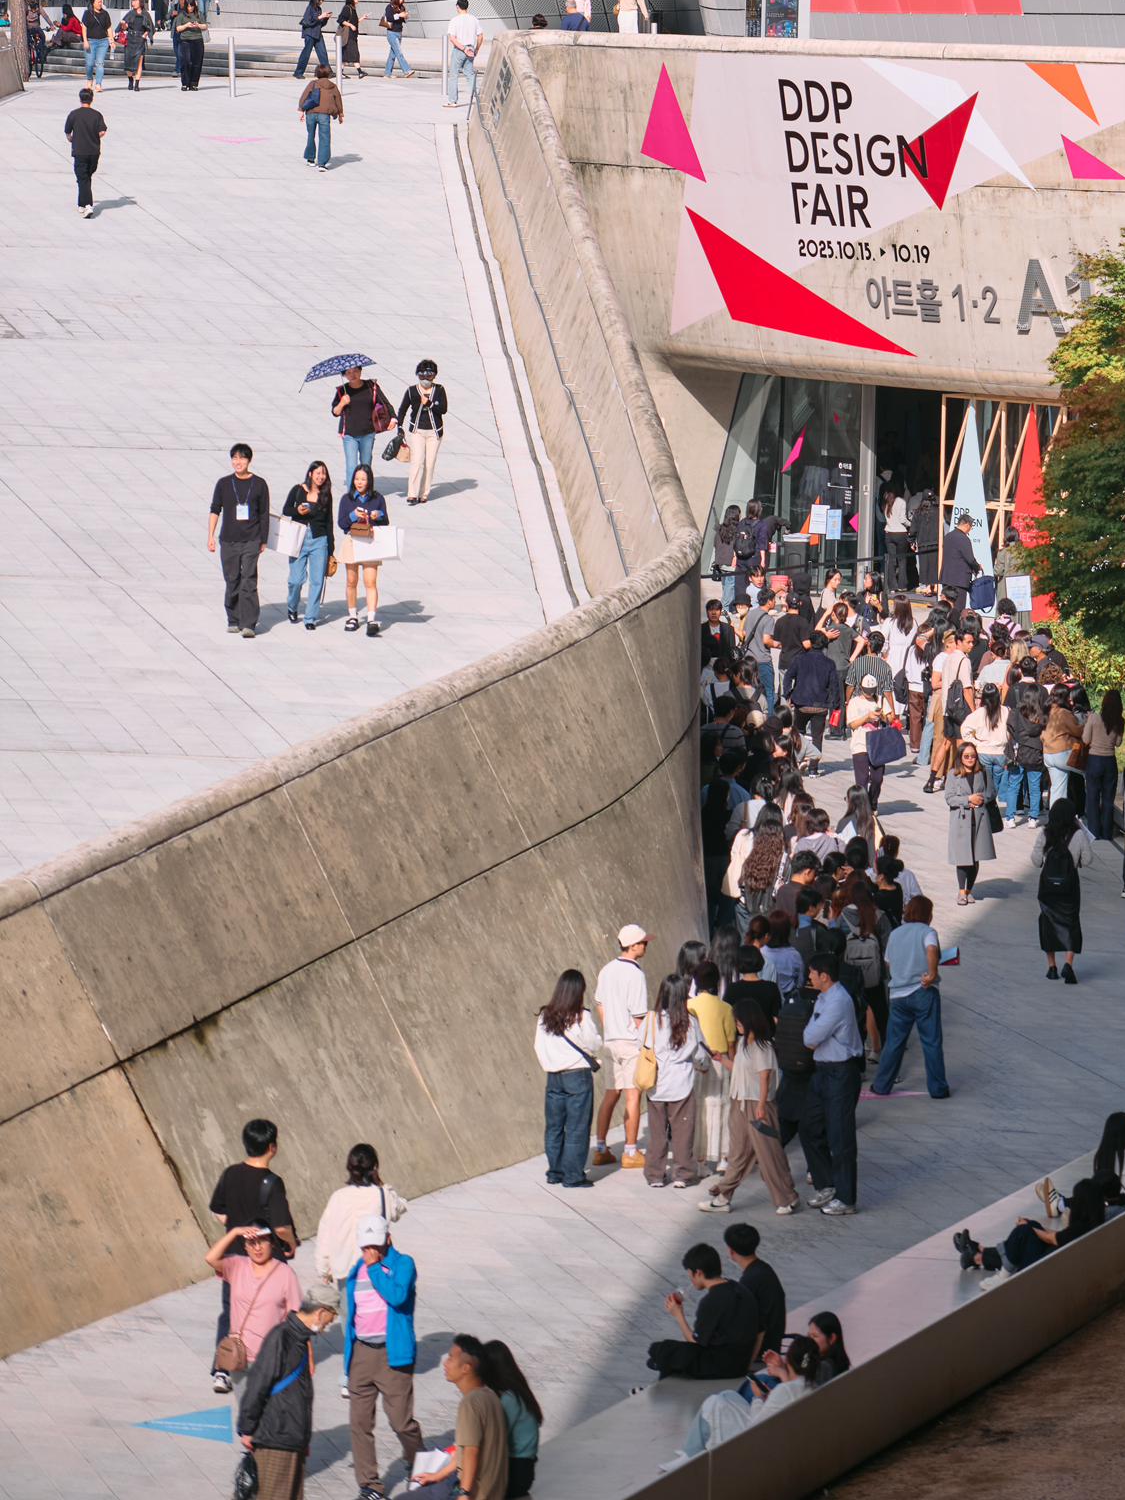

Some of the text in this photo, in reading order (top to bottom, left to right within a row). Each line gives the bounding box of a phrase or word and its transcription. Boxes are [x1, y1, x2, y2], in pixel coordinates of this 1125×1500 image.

[778, 78, 852, 124] DDP
[785, 130, 929, 180] DESIGN
[790, 181, 872, 229] FAIR
[798, 238, 931, 265] 2025.10.15. 10.19
[865, 276, 943, 324] 아트홀
[954, 506, 970, 516] DDP
[1014, 512, 1038, 522] SEOU
